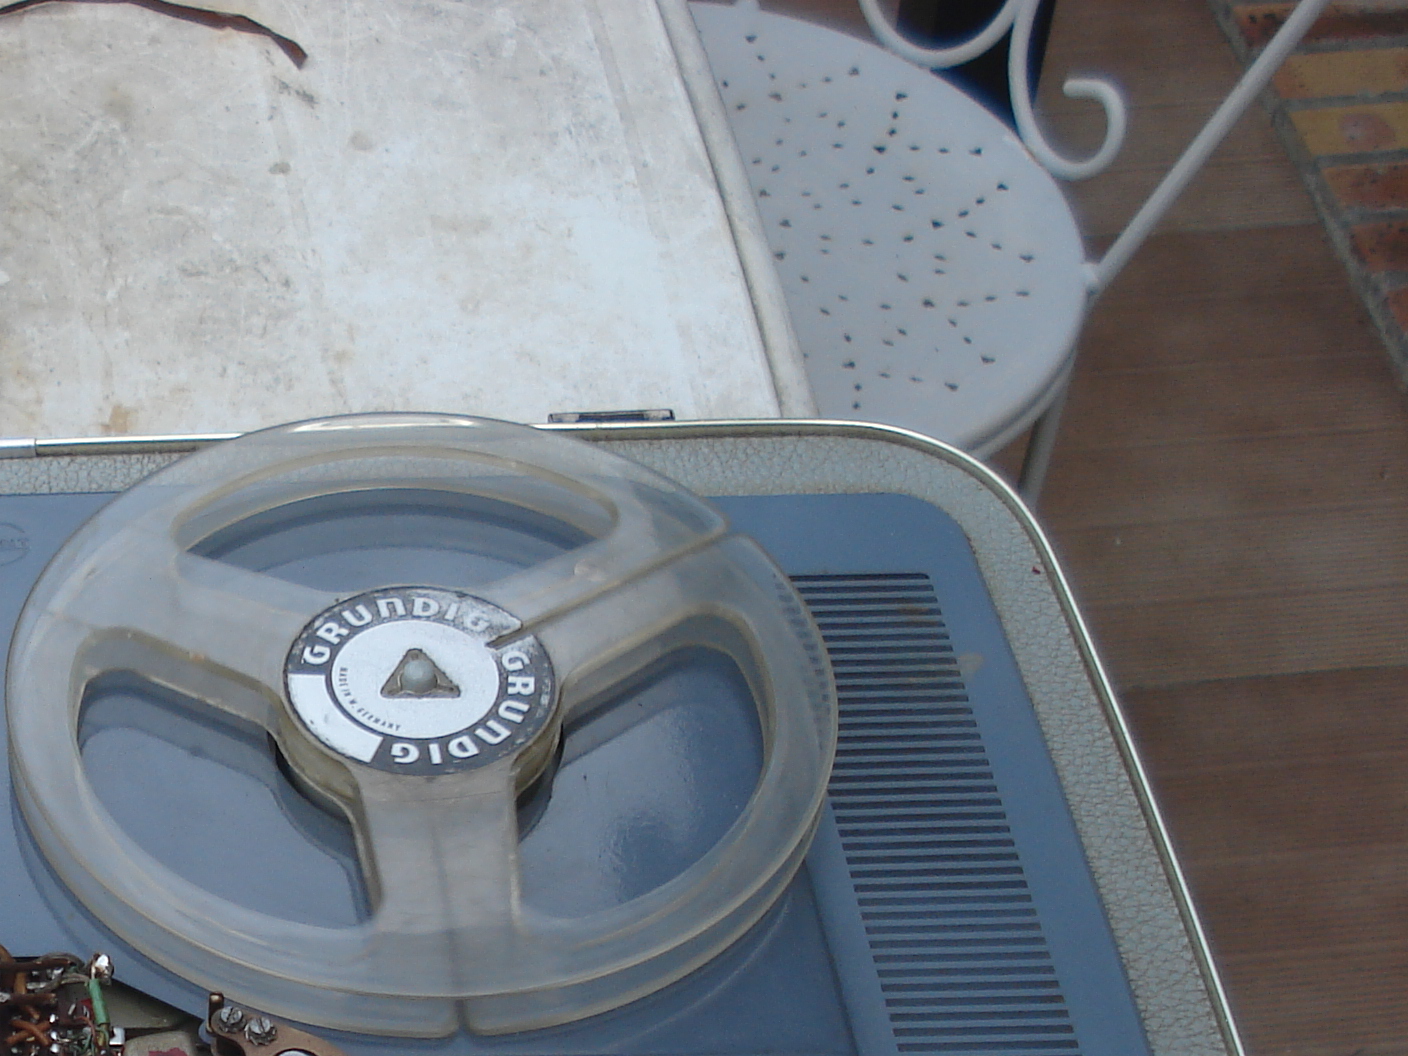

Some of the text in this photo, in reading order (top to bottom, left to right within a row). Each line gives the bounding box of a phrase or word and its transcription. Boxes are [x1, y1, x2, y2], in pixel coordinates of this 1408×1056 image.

[302, 596, 492, 665] GRUNDIG
[357, 708, 402, 732] GERMANY
[391, 650, 536, 765] GRUNDIG
